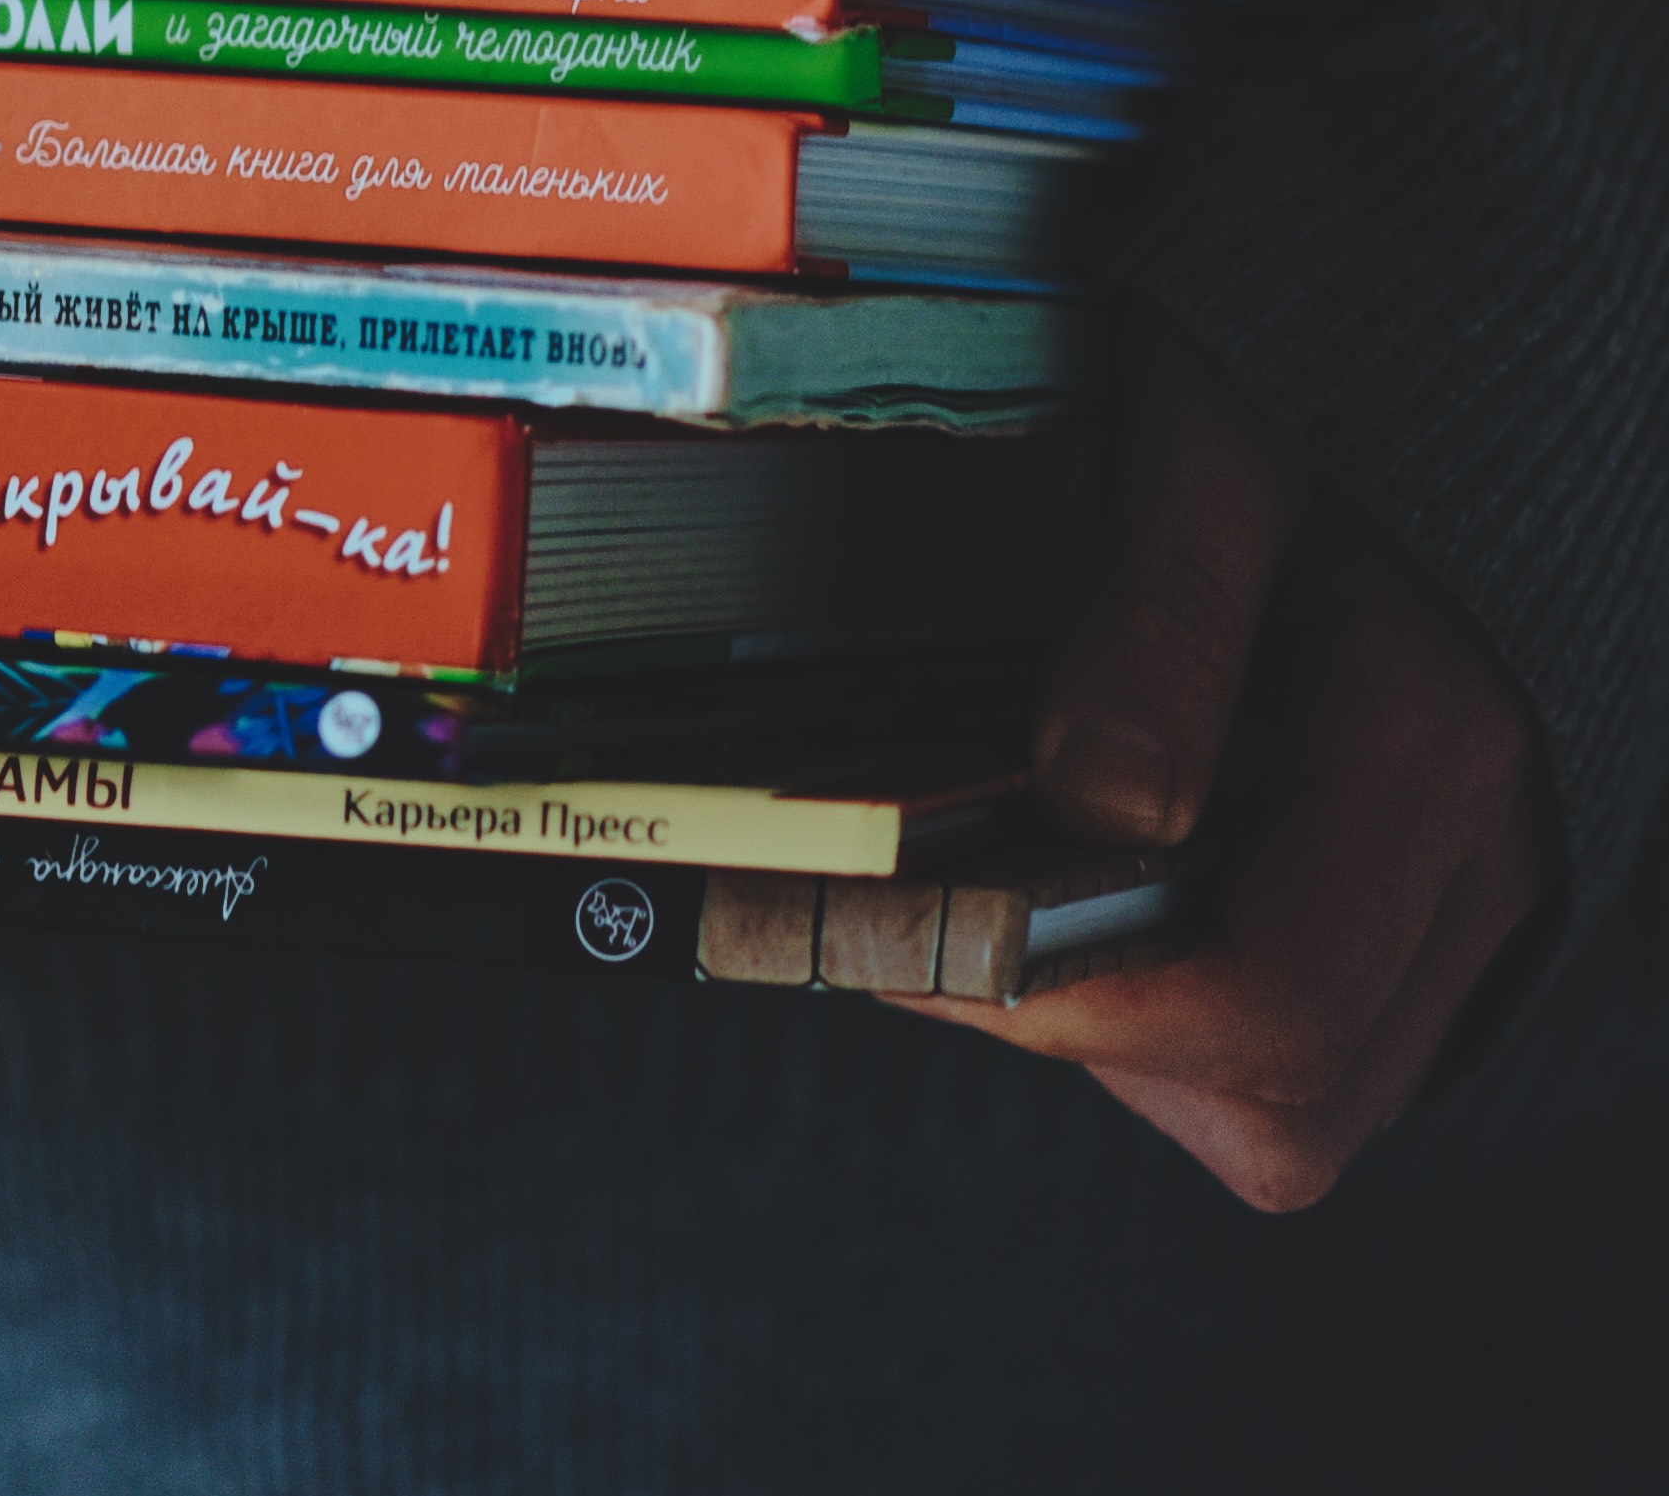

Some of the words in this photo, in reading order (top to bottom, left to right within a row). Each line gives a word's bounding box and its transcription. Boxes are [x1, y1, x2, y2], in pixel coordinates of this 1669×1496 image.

[165, 11, 189, 43] и
[200, 7, 442, 67] загадочный
[453, 21, 702, 83] чемоданчик
[15, 120, 217, 177] Большая
[227, 140, 337, 189] книга
[345, 152, 432, 203] для
[444, 159, 669, 205] маленьких
[54, 291, 161, 335] ЖИВЁТ
[172, 301, 211, 337] НА
[220, 306, 348, 352] КРЫШЕ,
[359, 316, 537, 362] ПРИЛЕТАЕТ
[343, 789, 520, 844] Карьера
[540, 803, 670, 847] Пресс
[25, 832, 266, 921] Александра
